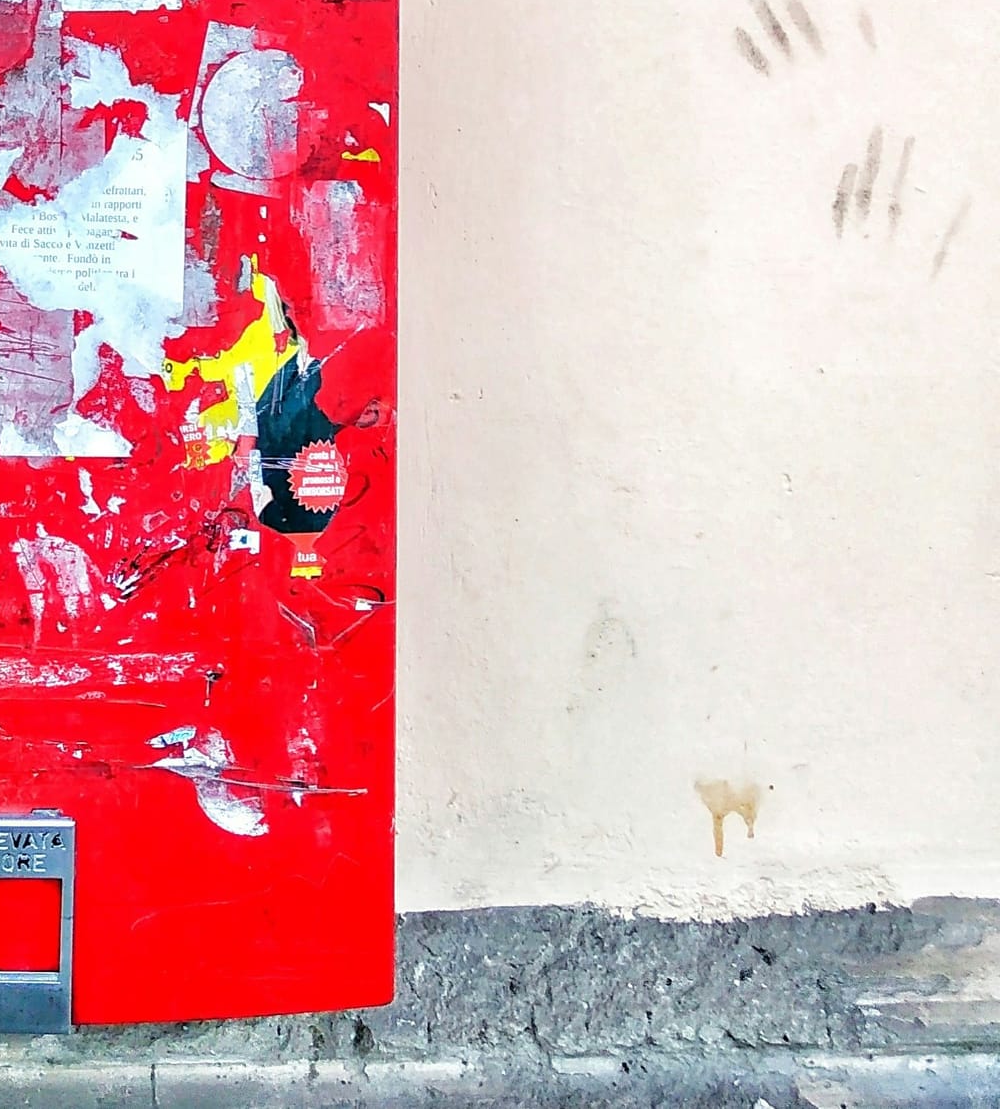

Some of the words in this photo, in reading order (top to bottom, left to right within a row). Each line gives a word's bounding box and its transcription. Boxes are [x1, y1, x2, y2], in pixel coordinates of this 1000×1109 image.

[104, 200, 142, 212] rapporti
[11, 224, 35, 235] Fece
[0, 237, 18, 247] vita
[20, 237, 31, 248] di
[33, 238, 63, 249] Sacco
[101, 253, 112, 265] in
[297, 551, 318, 563] tua
[1, 853, 48, 873] ORE
